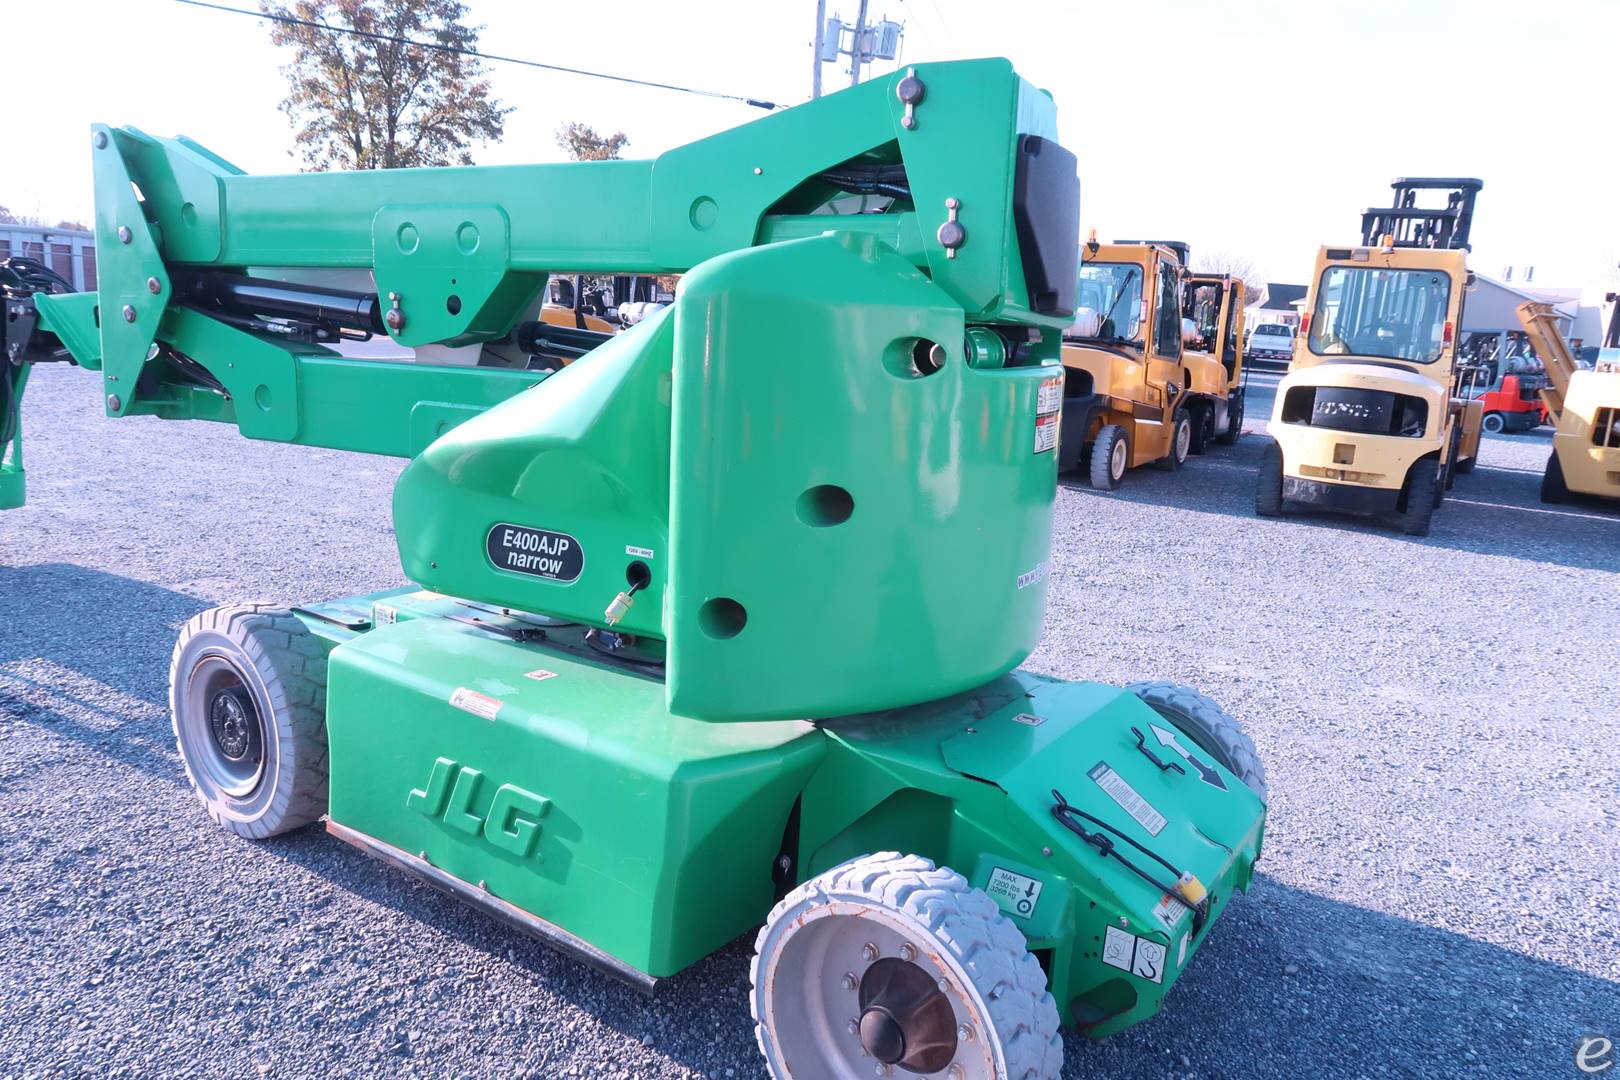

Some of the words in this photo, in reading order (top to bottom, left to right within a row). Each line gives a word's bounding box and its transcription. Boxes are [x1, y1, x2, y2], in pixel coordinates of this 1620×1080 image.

[503, 529, 570, 556] E400AJP
[507, 552, 563, 574] narrow
[406, 756, 552, 858] JLG
[993, 879, 1009, 889] 7200
[1010, 884, 1020, 893] lbs
[1001, 873, 1017, 883] MAX
[1008, 891, 1016, 900] kg
